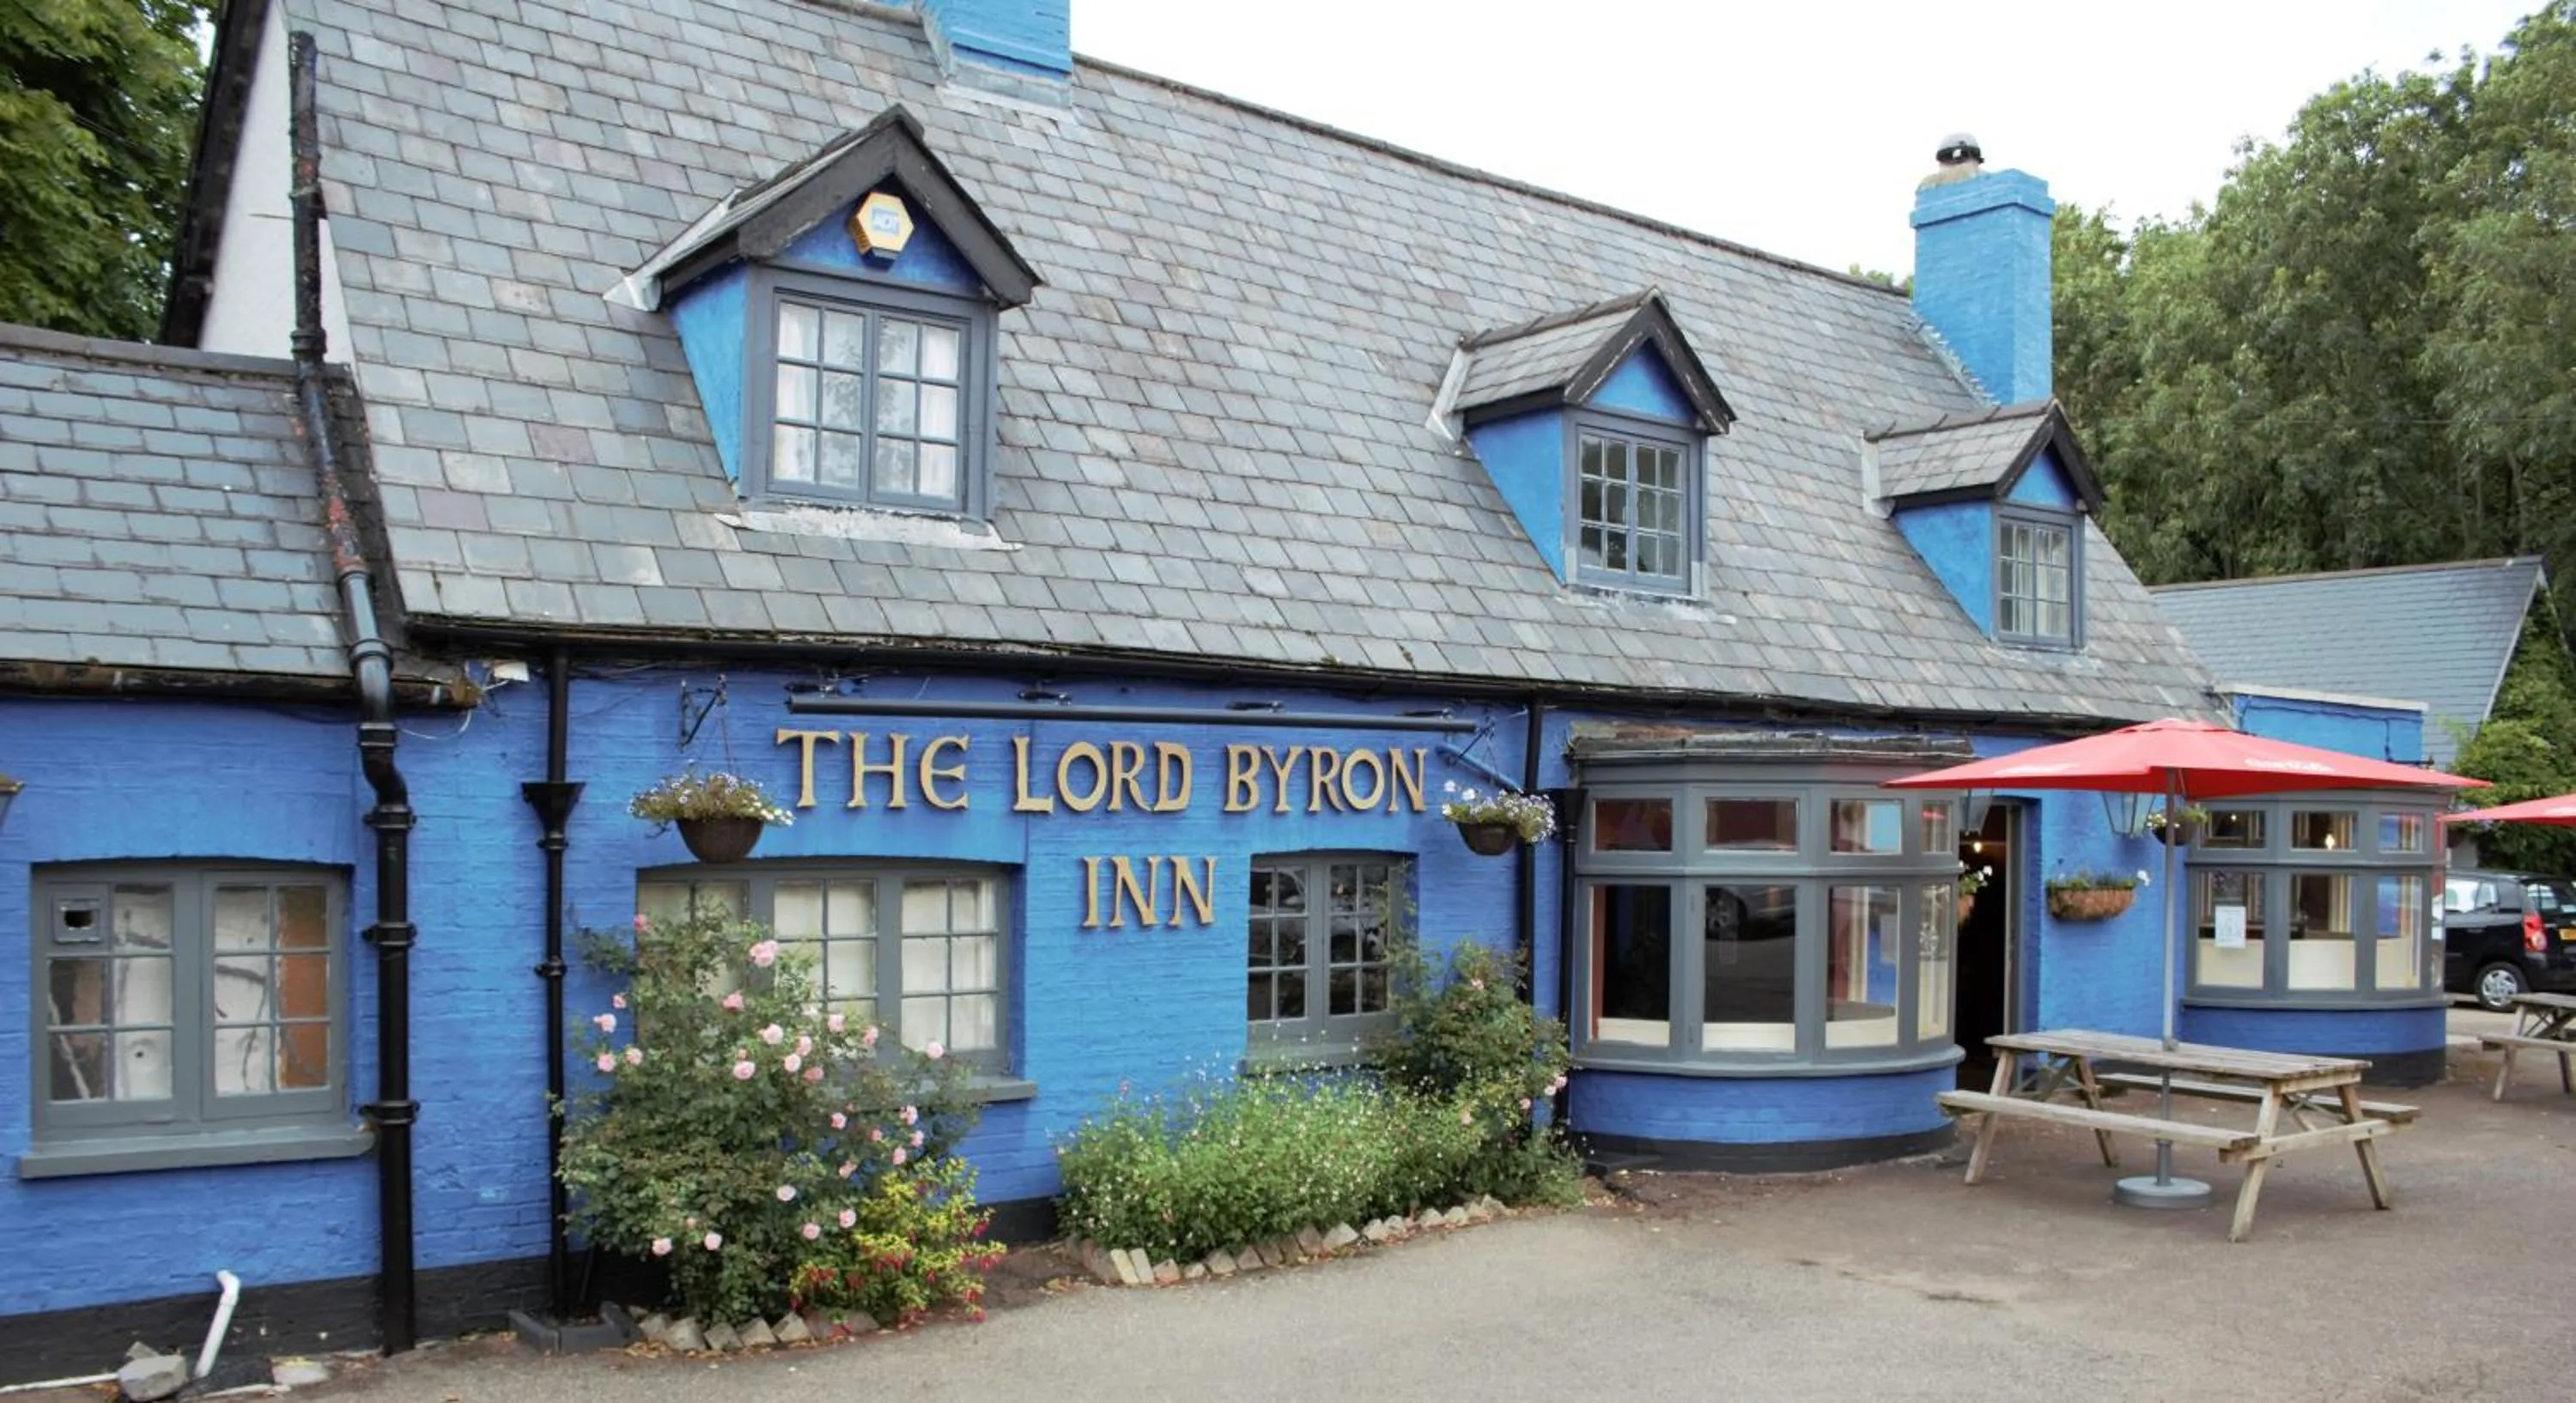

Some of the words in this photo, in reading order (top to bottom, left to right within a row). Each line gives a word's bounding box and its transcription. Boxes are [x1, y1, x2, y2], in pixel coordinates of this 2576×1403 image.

[776, 728, 969, 809] THE
[1013, 736, 1193, 814] LORD
[1224, 744, 1427, 812] BYRON
[1084, 855, 1216, 927] INN
